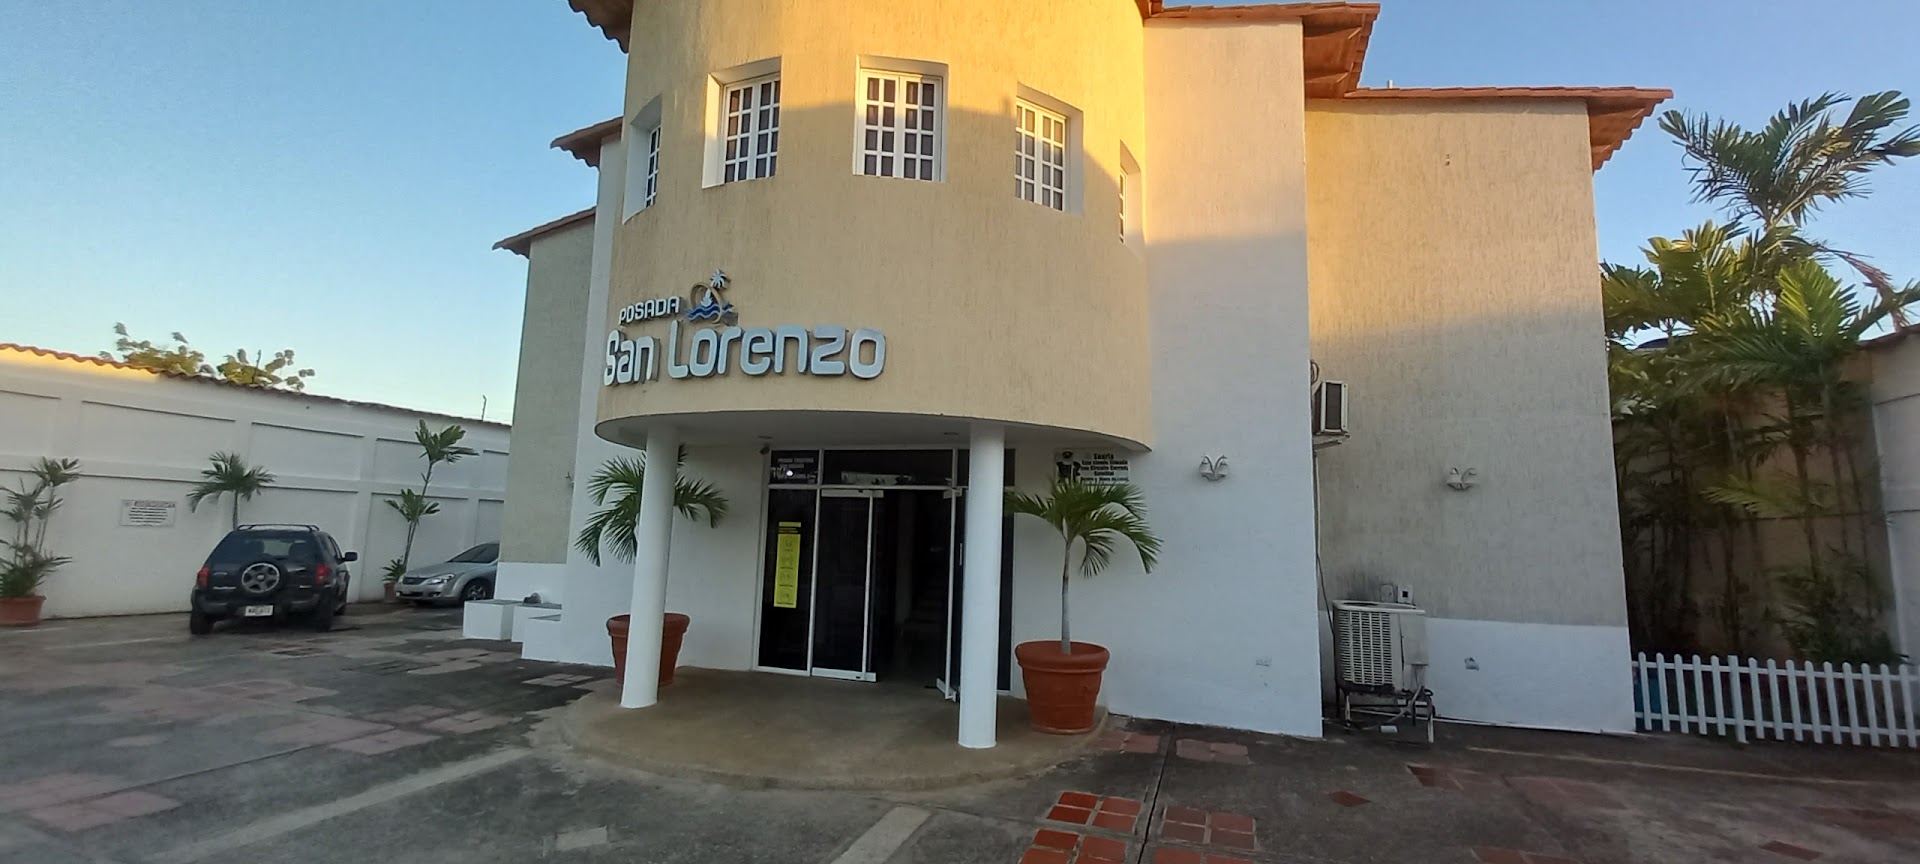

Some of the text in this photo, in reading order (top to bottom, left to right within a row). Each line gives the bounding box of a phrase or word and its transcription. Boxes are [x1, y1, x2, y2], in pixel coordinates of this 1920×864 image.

[618, 296, 680, 326] POSADA
[604, 319, 886, 386] San Lorenzo
